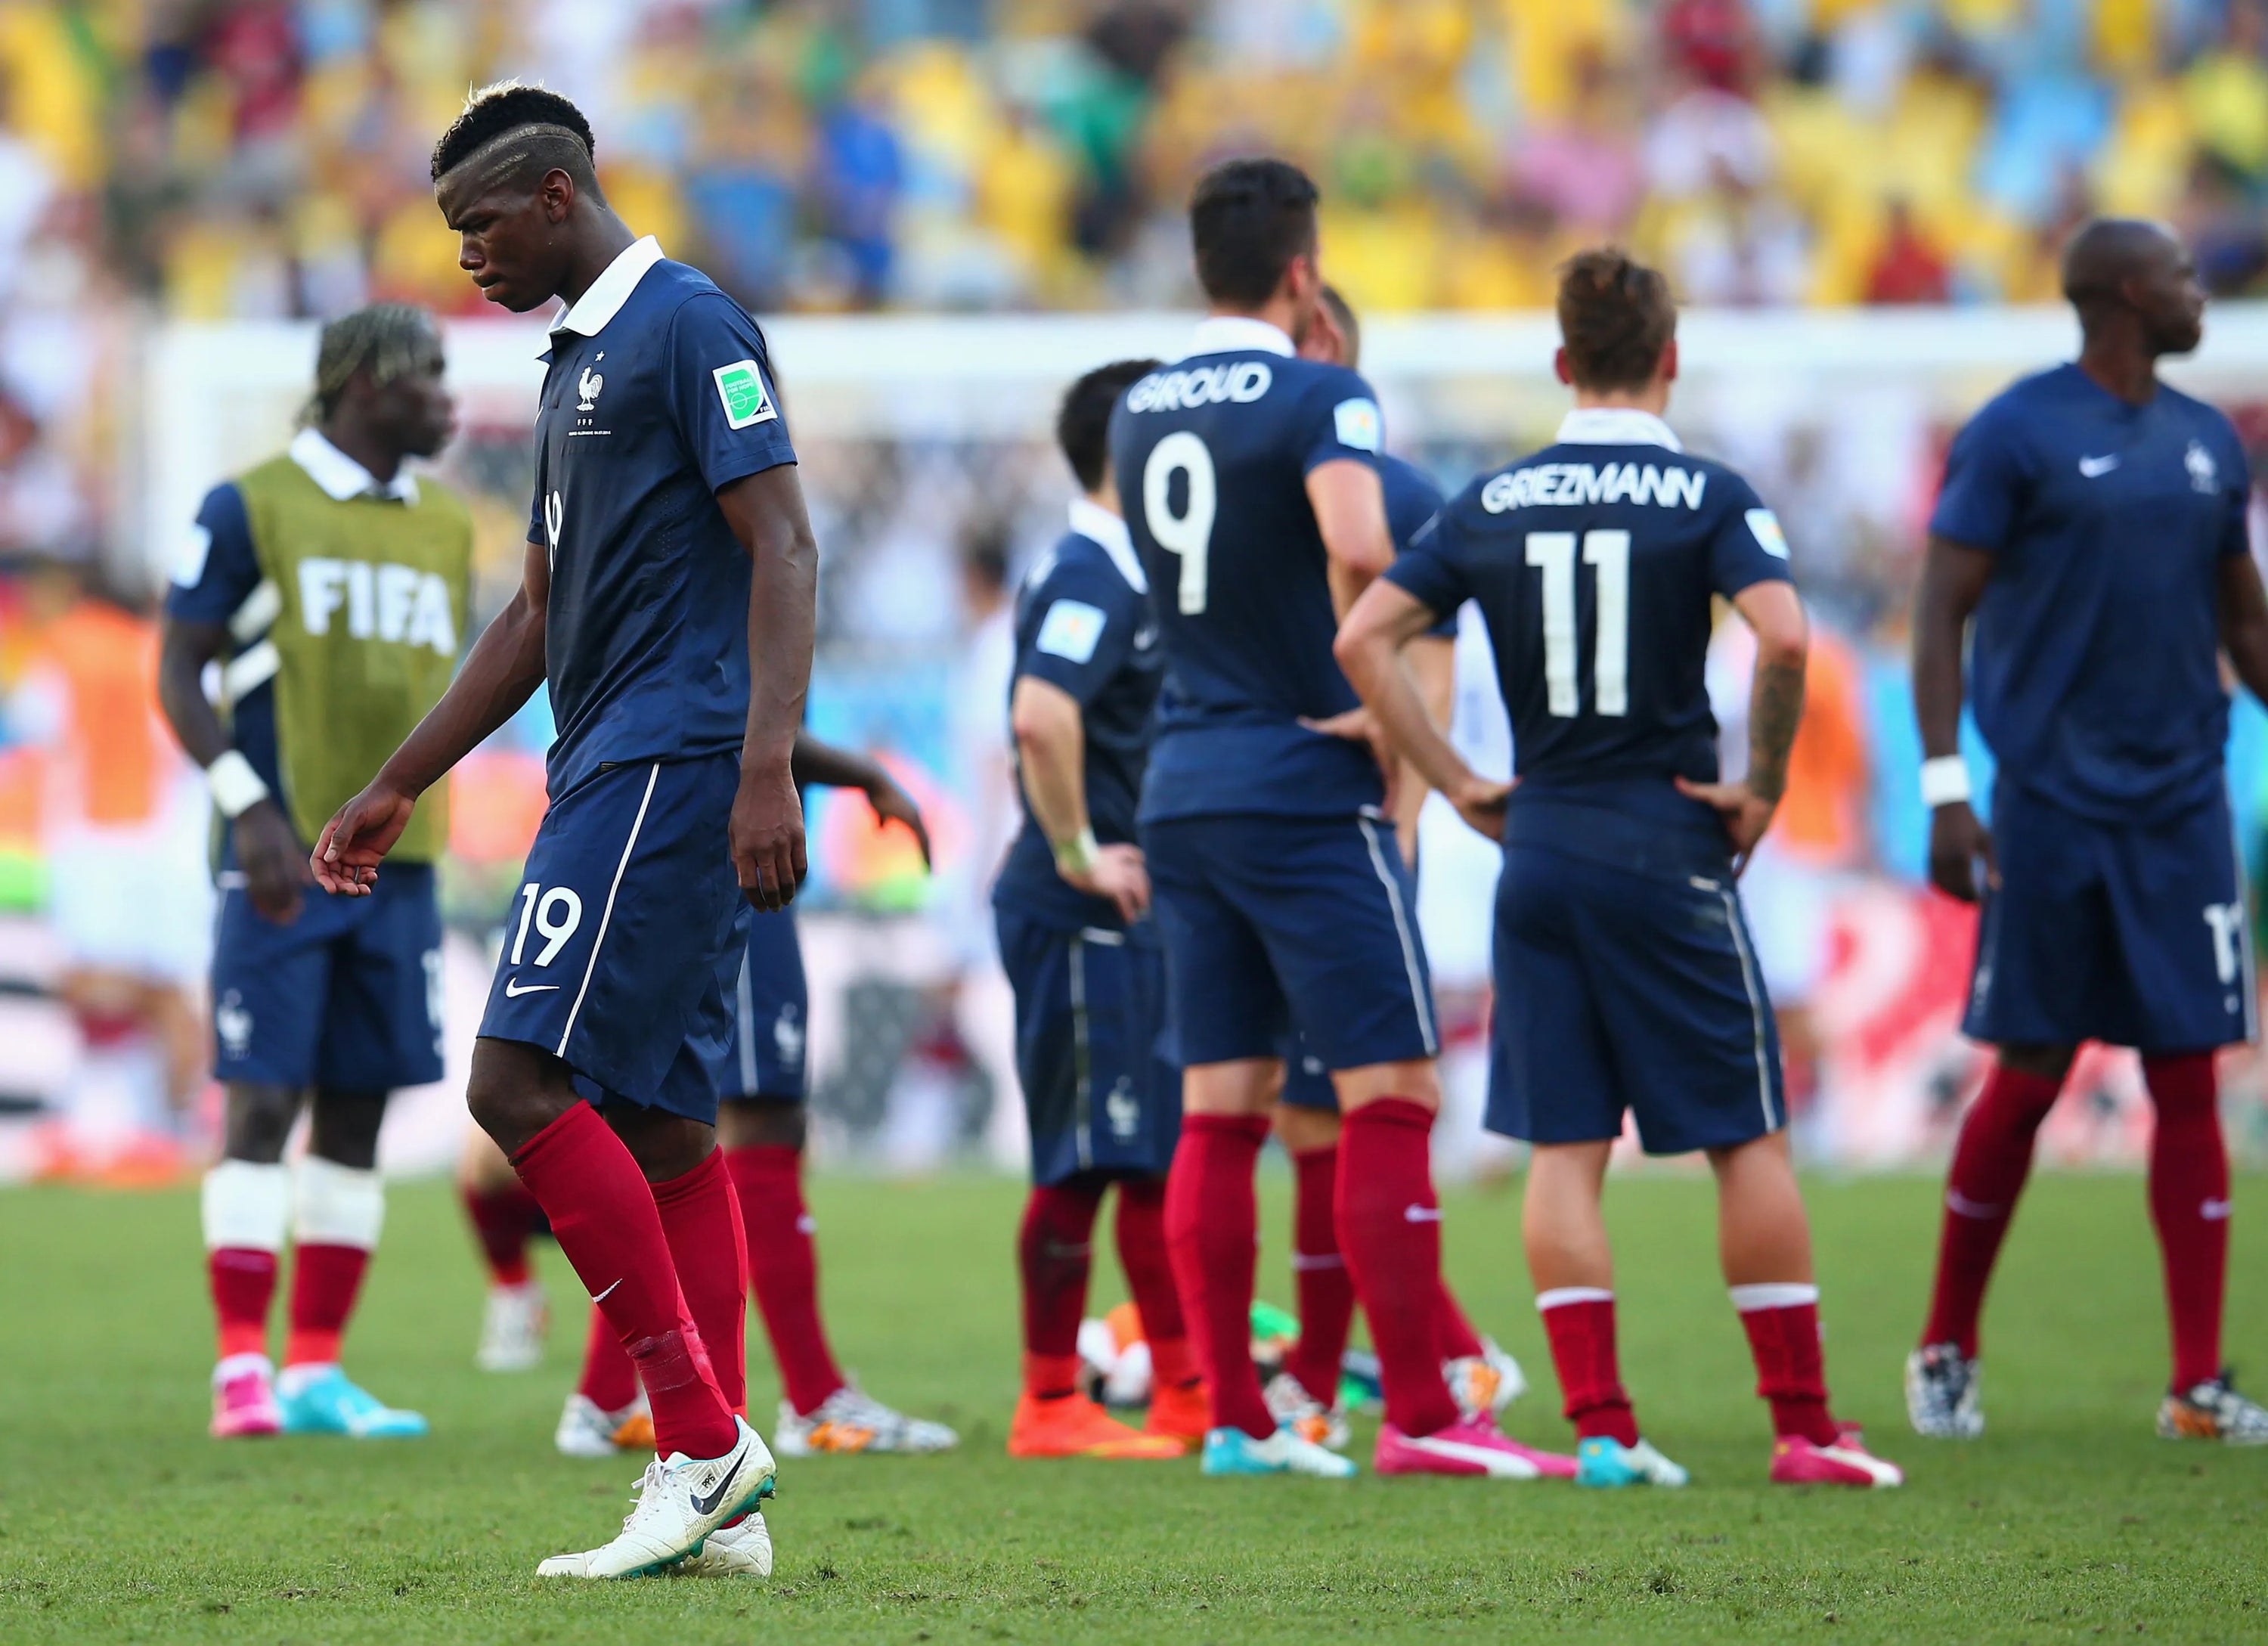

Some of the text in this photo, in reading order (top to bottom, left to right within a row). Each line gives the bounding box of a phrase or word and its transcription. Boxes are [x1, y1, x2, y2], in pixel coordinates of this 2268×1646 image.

[1126, 361, 1272, 414] GIROUD
[1142, 429, 1216, 616] 9
[1481, 461, 1706, 514] GRIEZMANN
[298, 556, 457, 656] FIFA
[1524, 529, 1631, 718] 11
[510, 882, 582, 967] 19
